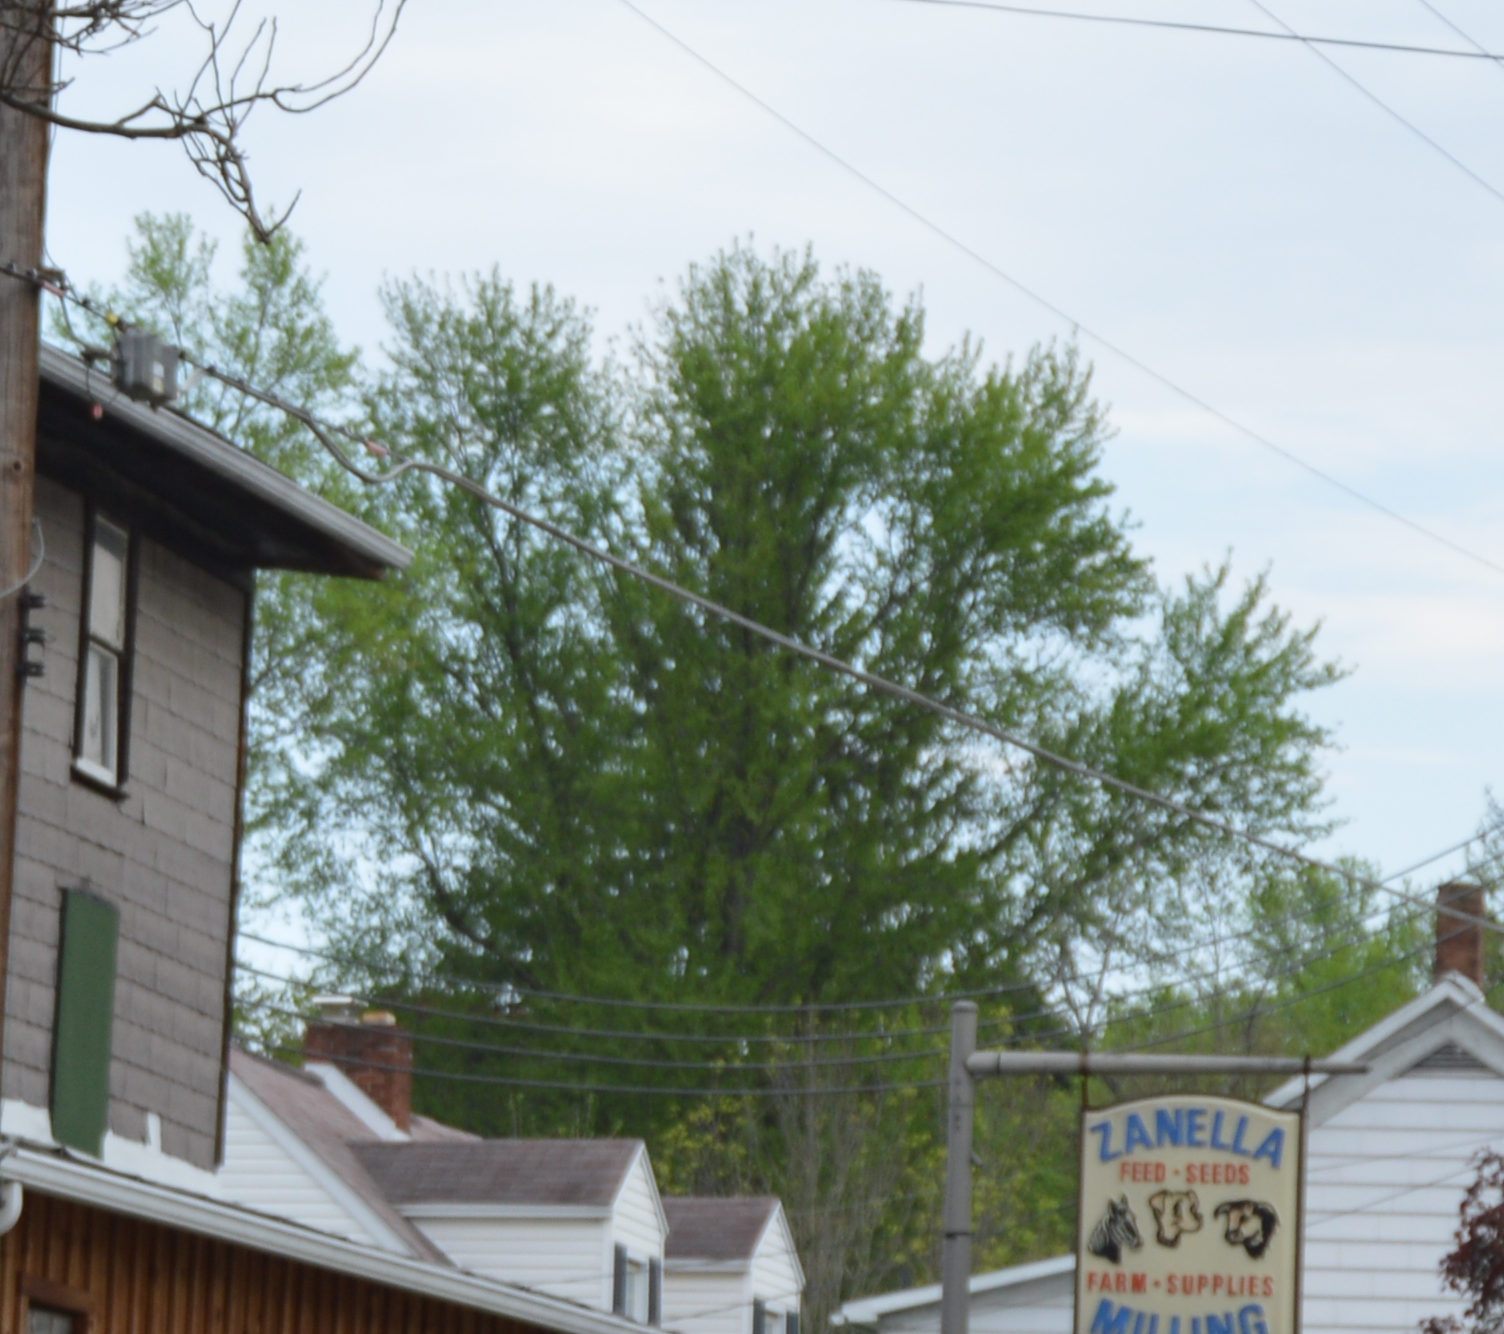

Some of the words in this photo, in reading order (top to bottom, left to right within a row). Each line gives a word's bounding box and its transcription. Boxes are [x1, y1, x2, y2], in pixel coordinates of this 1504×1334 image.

[1089, 1107, 1286, 1170] ZANELLA
[1119, 1161, 1166, 1183] FEED
[1185, 1162, 1251, 1185] SEEDS
[1087, 1271, 1148, 1293] FARM
[1167, 1273, 1274, 1297] SUPPLIES
